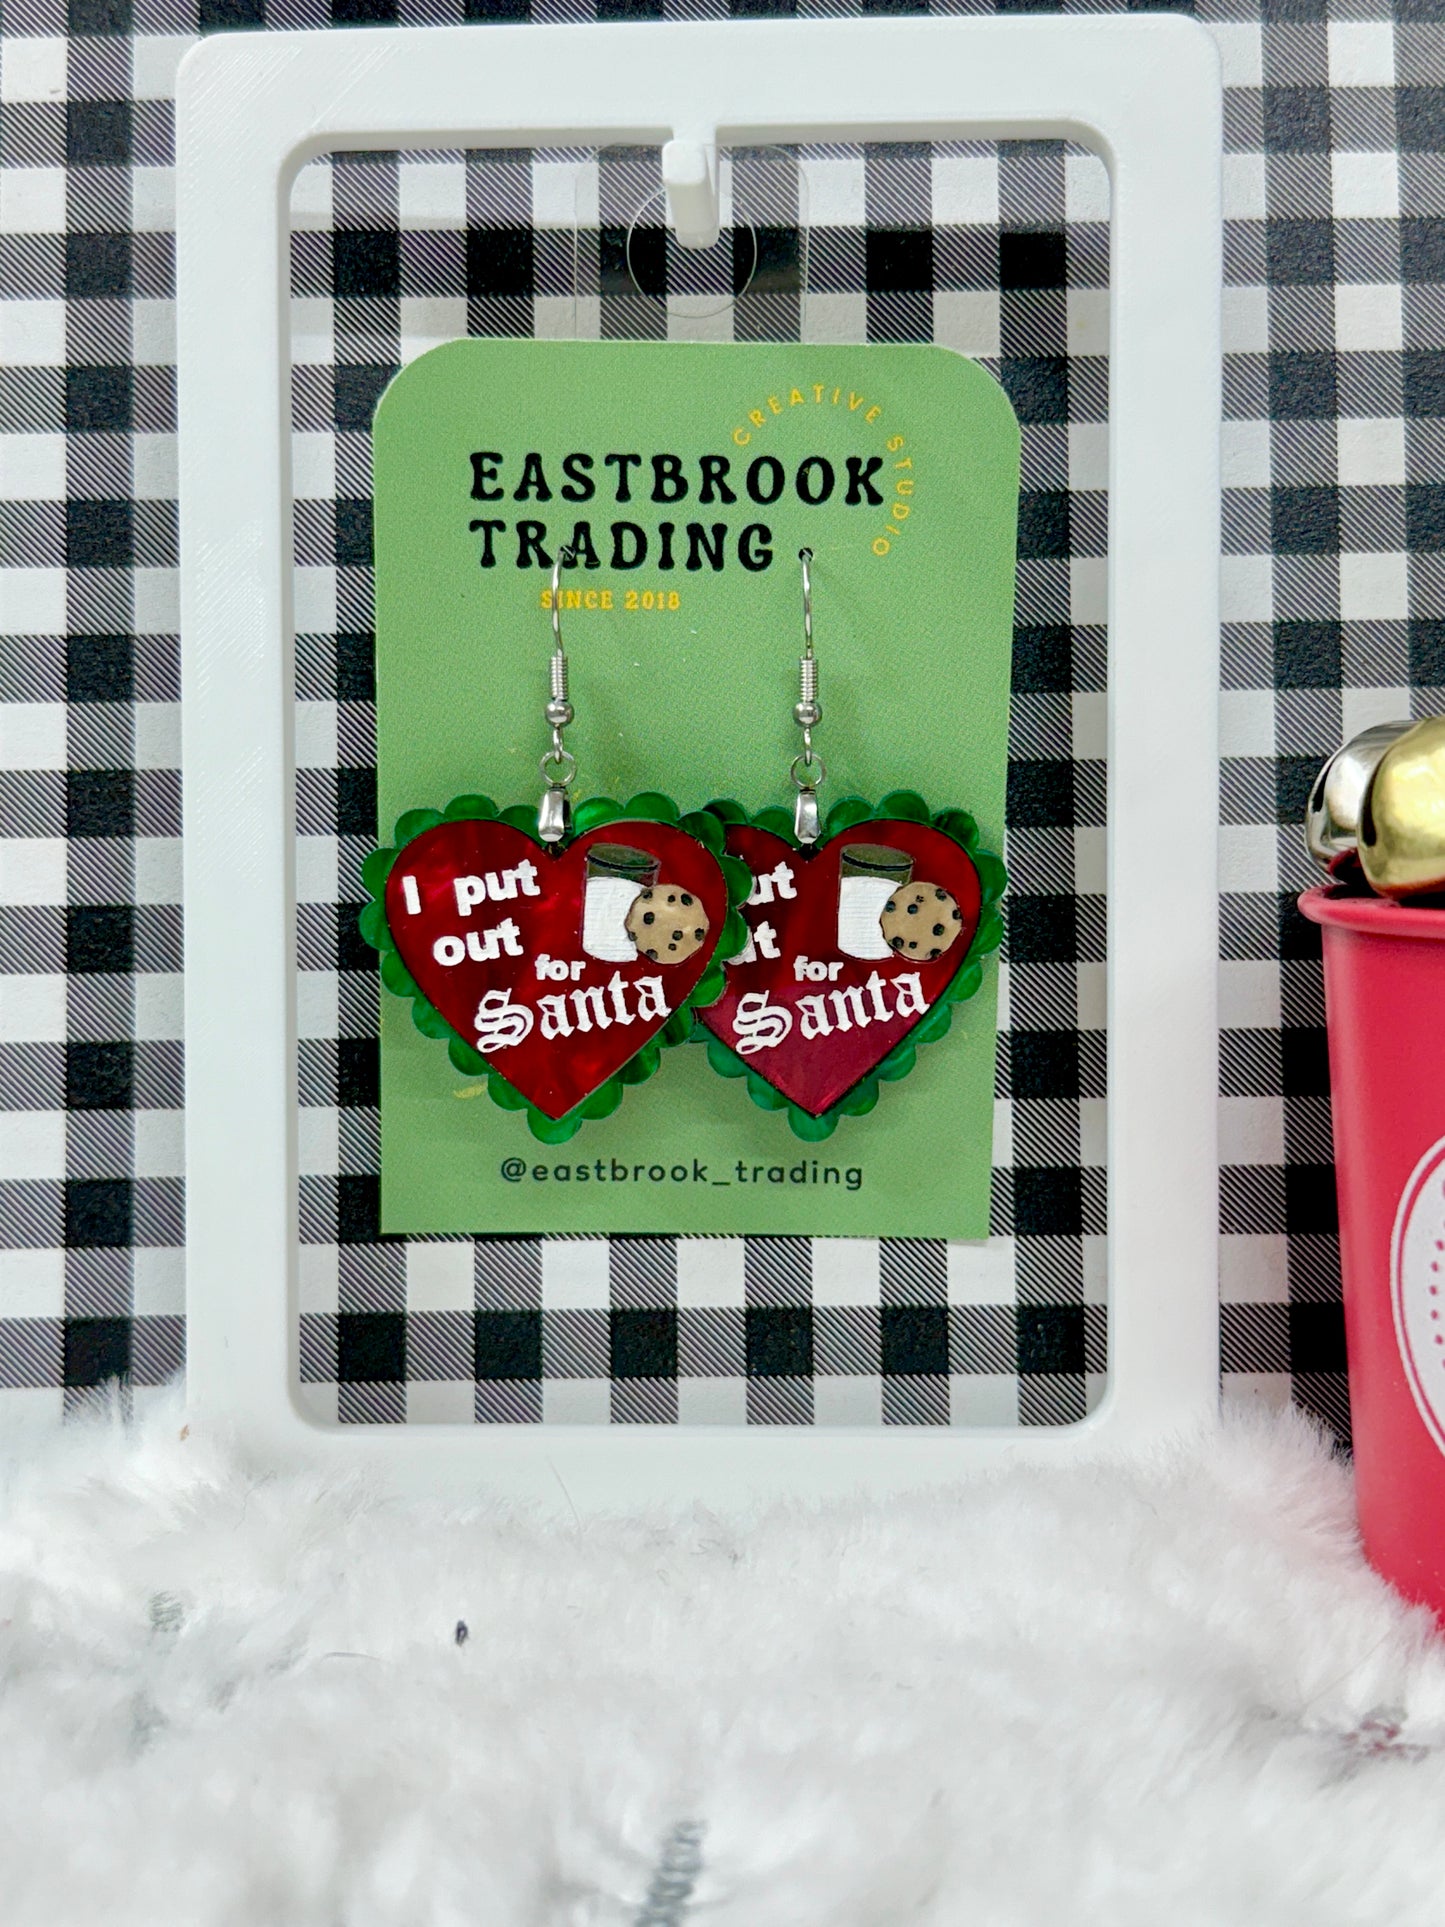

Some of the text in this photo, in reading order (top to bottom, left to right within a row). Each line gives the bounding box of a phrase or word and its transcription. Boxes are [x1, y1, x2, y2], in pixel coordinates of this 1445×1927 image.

[469, 451, 884, 506] EASTBROOK
[732, 384, 915, 557] CREATIVE STUDIO
[469, 519, 775, 572] TRADING
[540, 590, 682, 612] SINCE 2018
[402, 858, 541, 917] I put
[745, 861, 798, 906] ut
[432, 917, 524, 967] out
[534, 953, 587, 981] for
[793, 955, 844, 982] for
[474, 970, 672, 1054] Santa
[732, 970, 931, 1056] Santa
[500, 1156, 864, 1192] @eastbrook_trading
